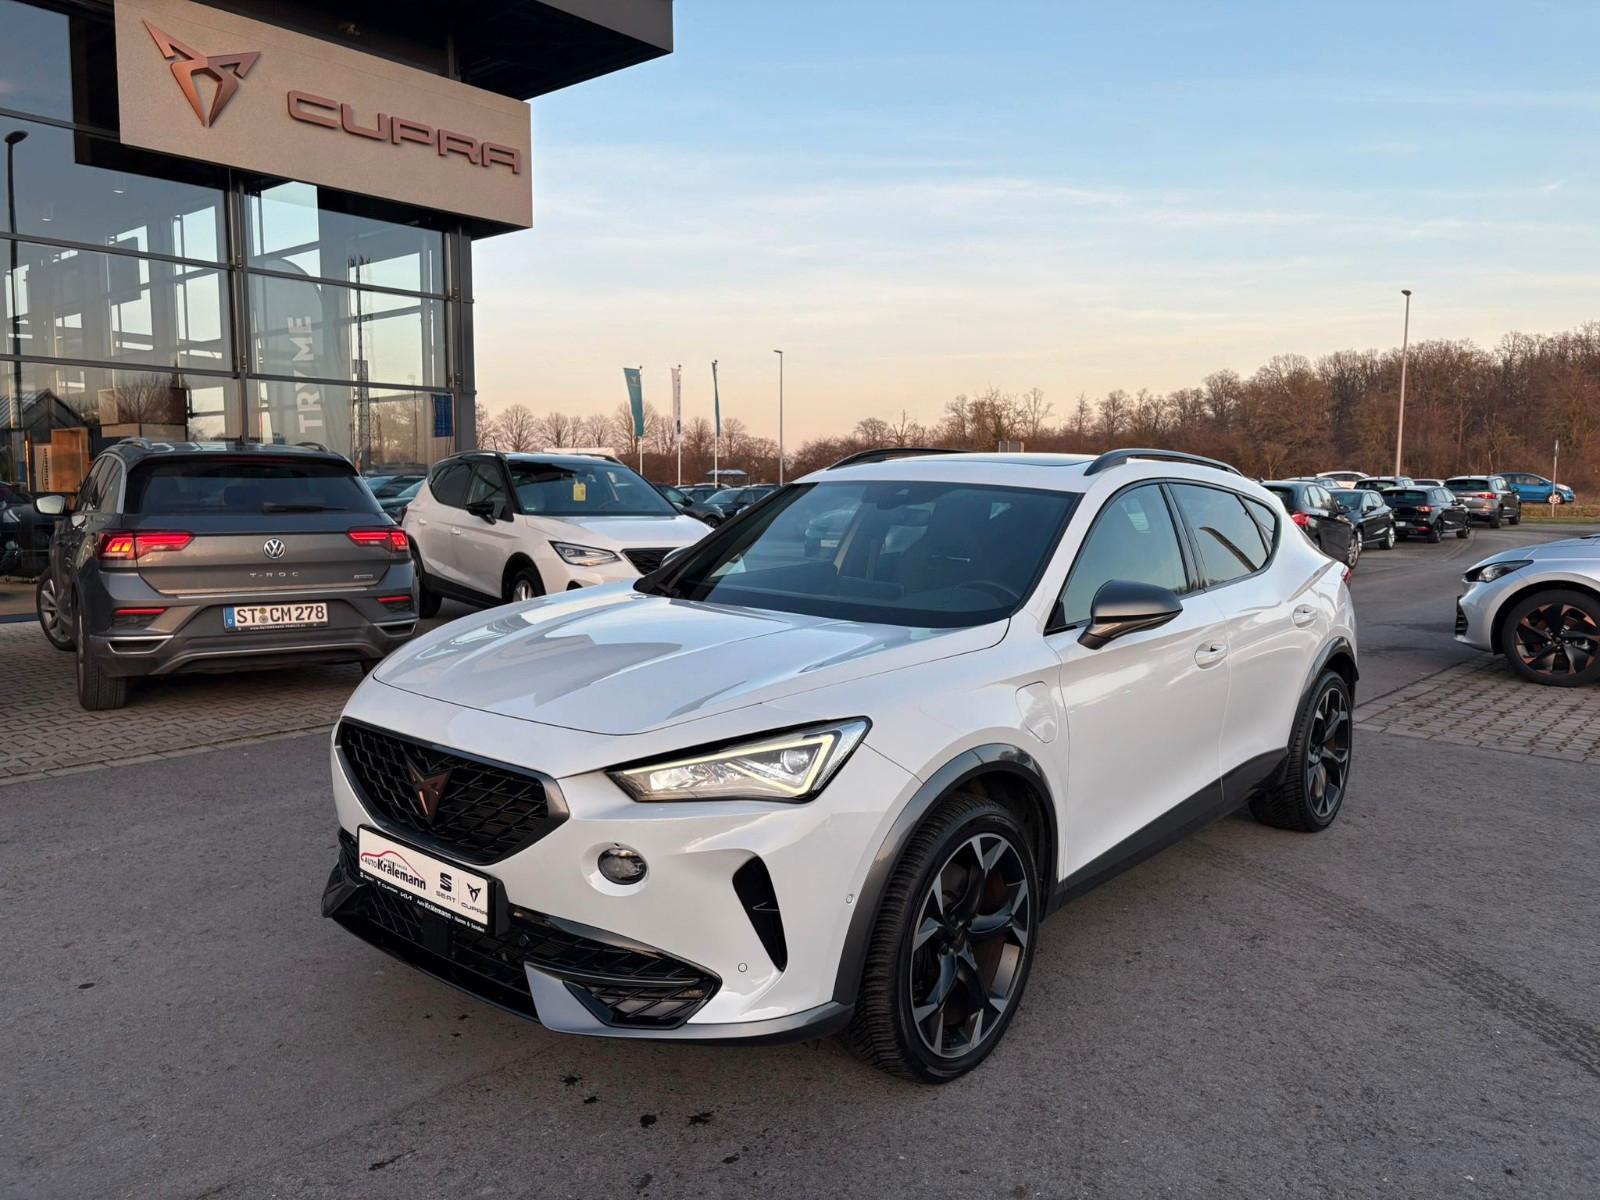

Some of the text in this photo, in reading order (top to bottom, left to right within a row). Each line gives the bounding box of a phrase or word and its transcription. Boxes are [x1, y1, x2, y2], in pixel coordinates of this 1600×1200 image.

[287, 90, 521, 175] CUPRA
[287, 316, 314, 360] ME
[236, 607, 258, 624] ST
[269, 606, 293, 622] CM
[295, 604, 325, 621] 278
[377, 858, 426, 890] Krälemann
[435, 890, 456, 903] SEAT
